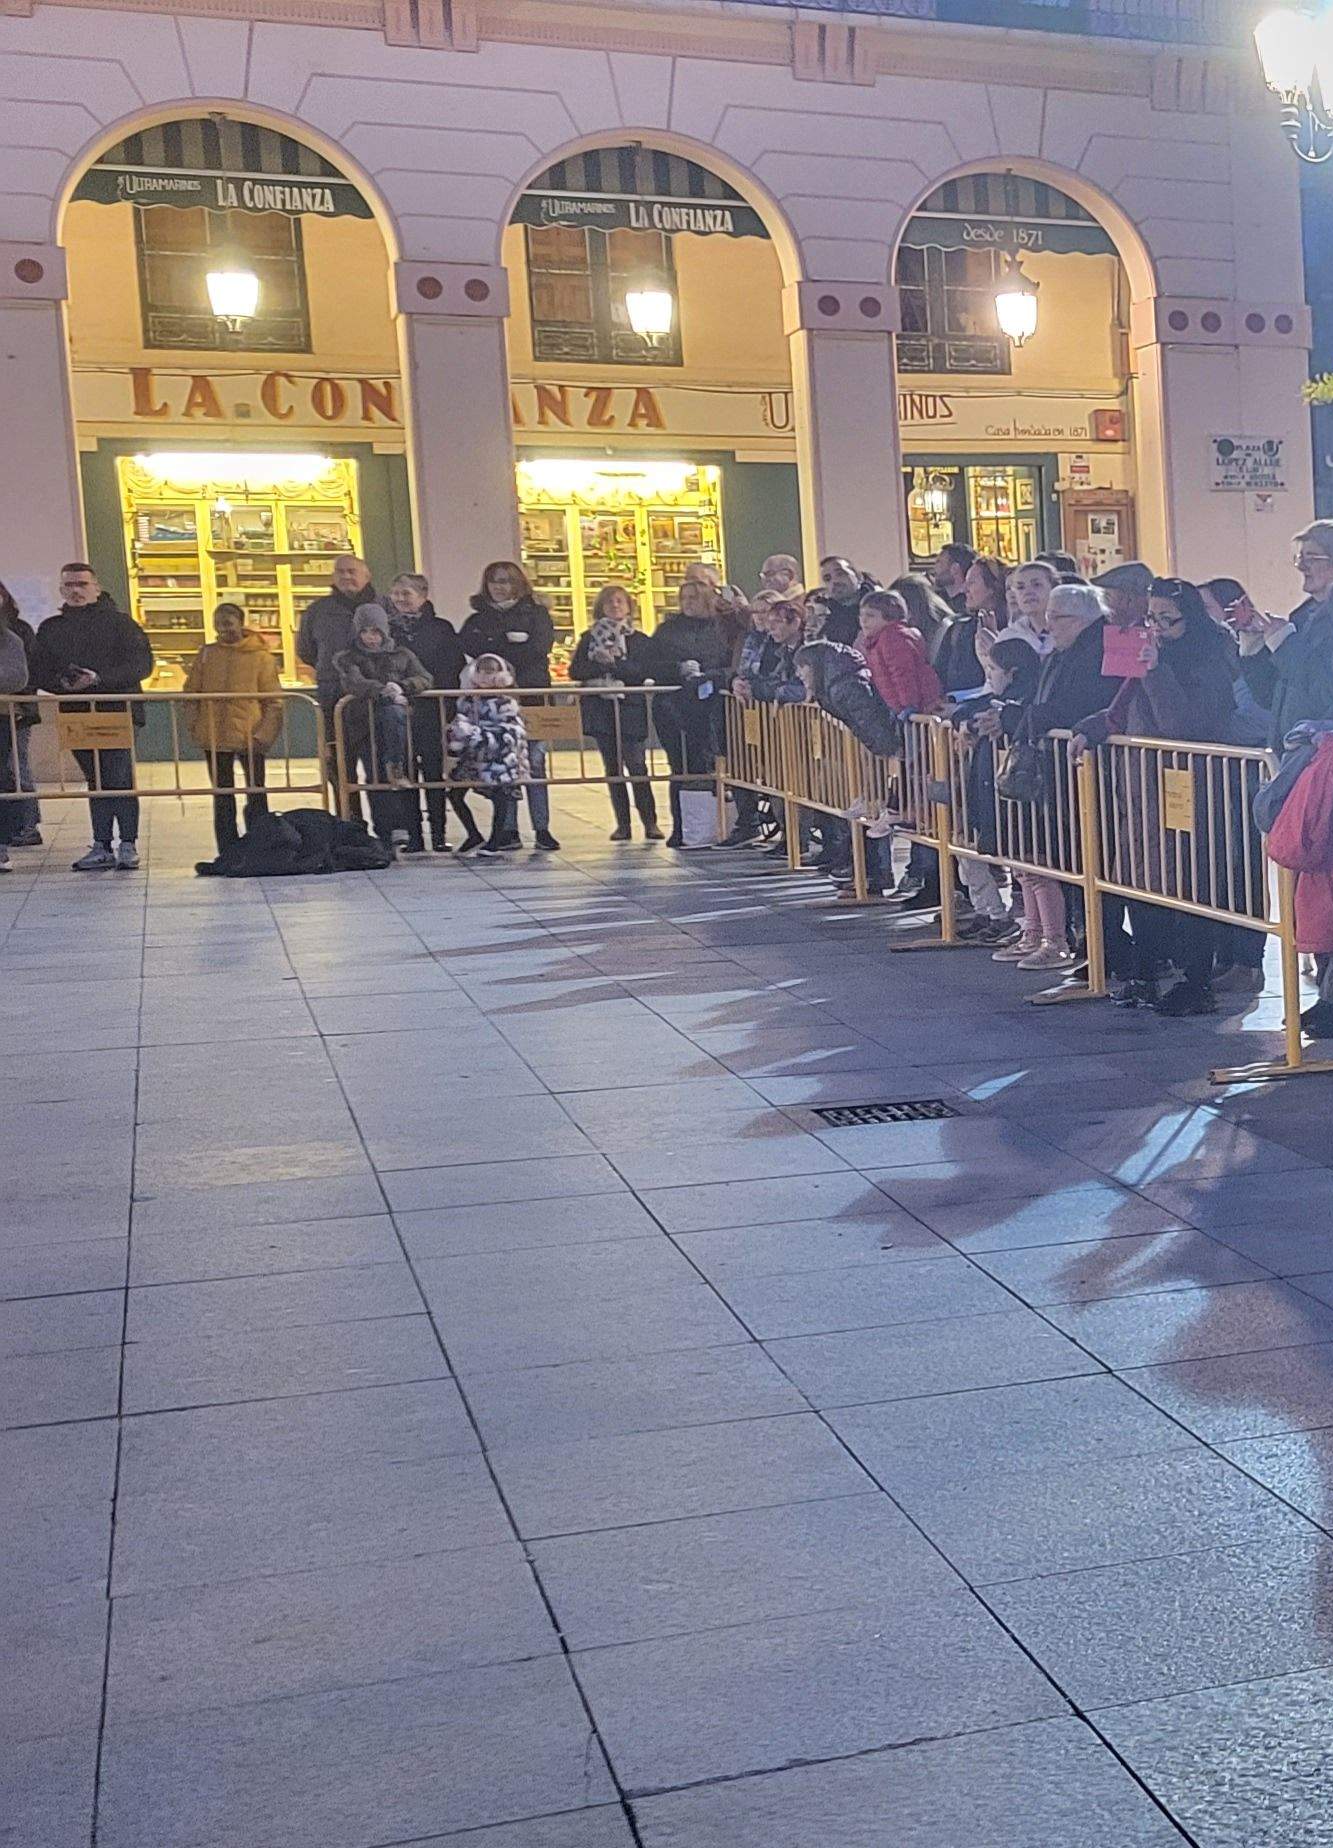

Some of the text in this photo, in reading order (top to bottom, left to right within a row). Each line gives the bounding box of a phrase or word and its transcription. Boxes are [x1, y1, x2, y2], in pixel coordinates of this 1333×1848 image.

[215, 178, 240, 207] LA
[242, 180, 335, 213] CONFIANZA
[629, 202, 650, 228] LA
[652, 203, 734, 233] CONFIANZA
[963, 222, 1043, 247] desde 1871
[130, 367, 225, 419] LA
